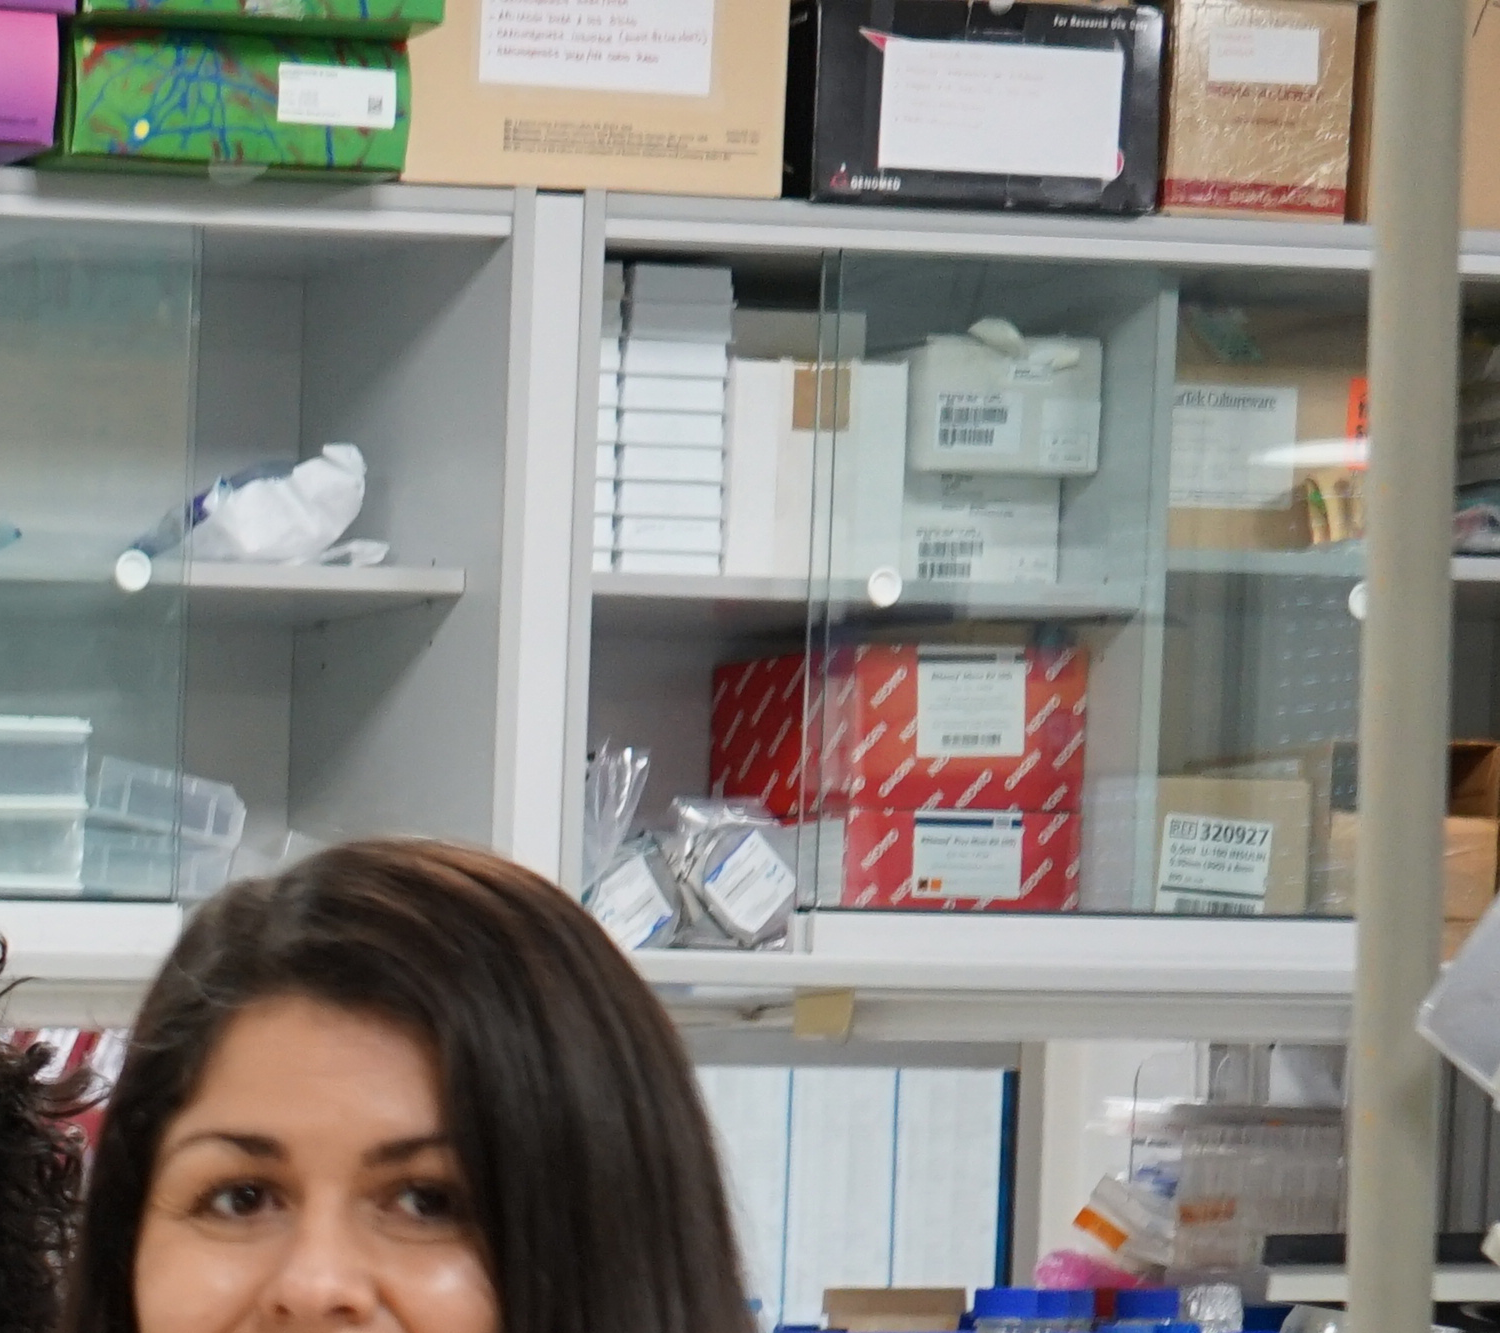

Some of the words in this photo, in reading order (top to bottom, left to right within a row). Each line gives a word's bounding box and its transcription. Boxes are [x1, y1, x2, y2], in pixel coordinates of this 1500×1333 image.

[1070, 14, 1108, 29] Research
[850, 175, 901, 191] GENOMED
[1201, 823, 1269, 847] 320927
